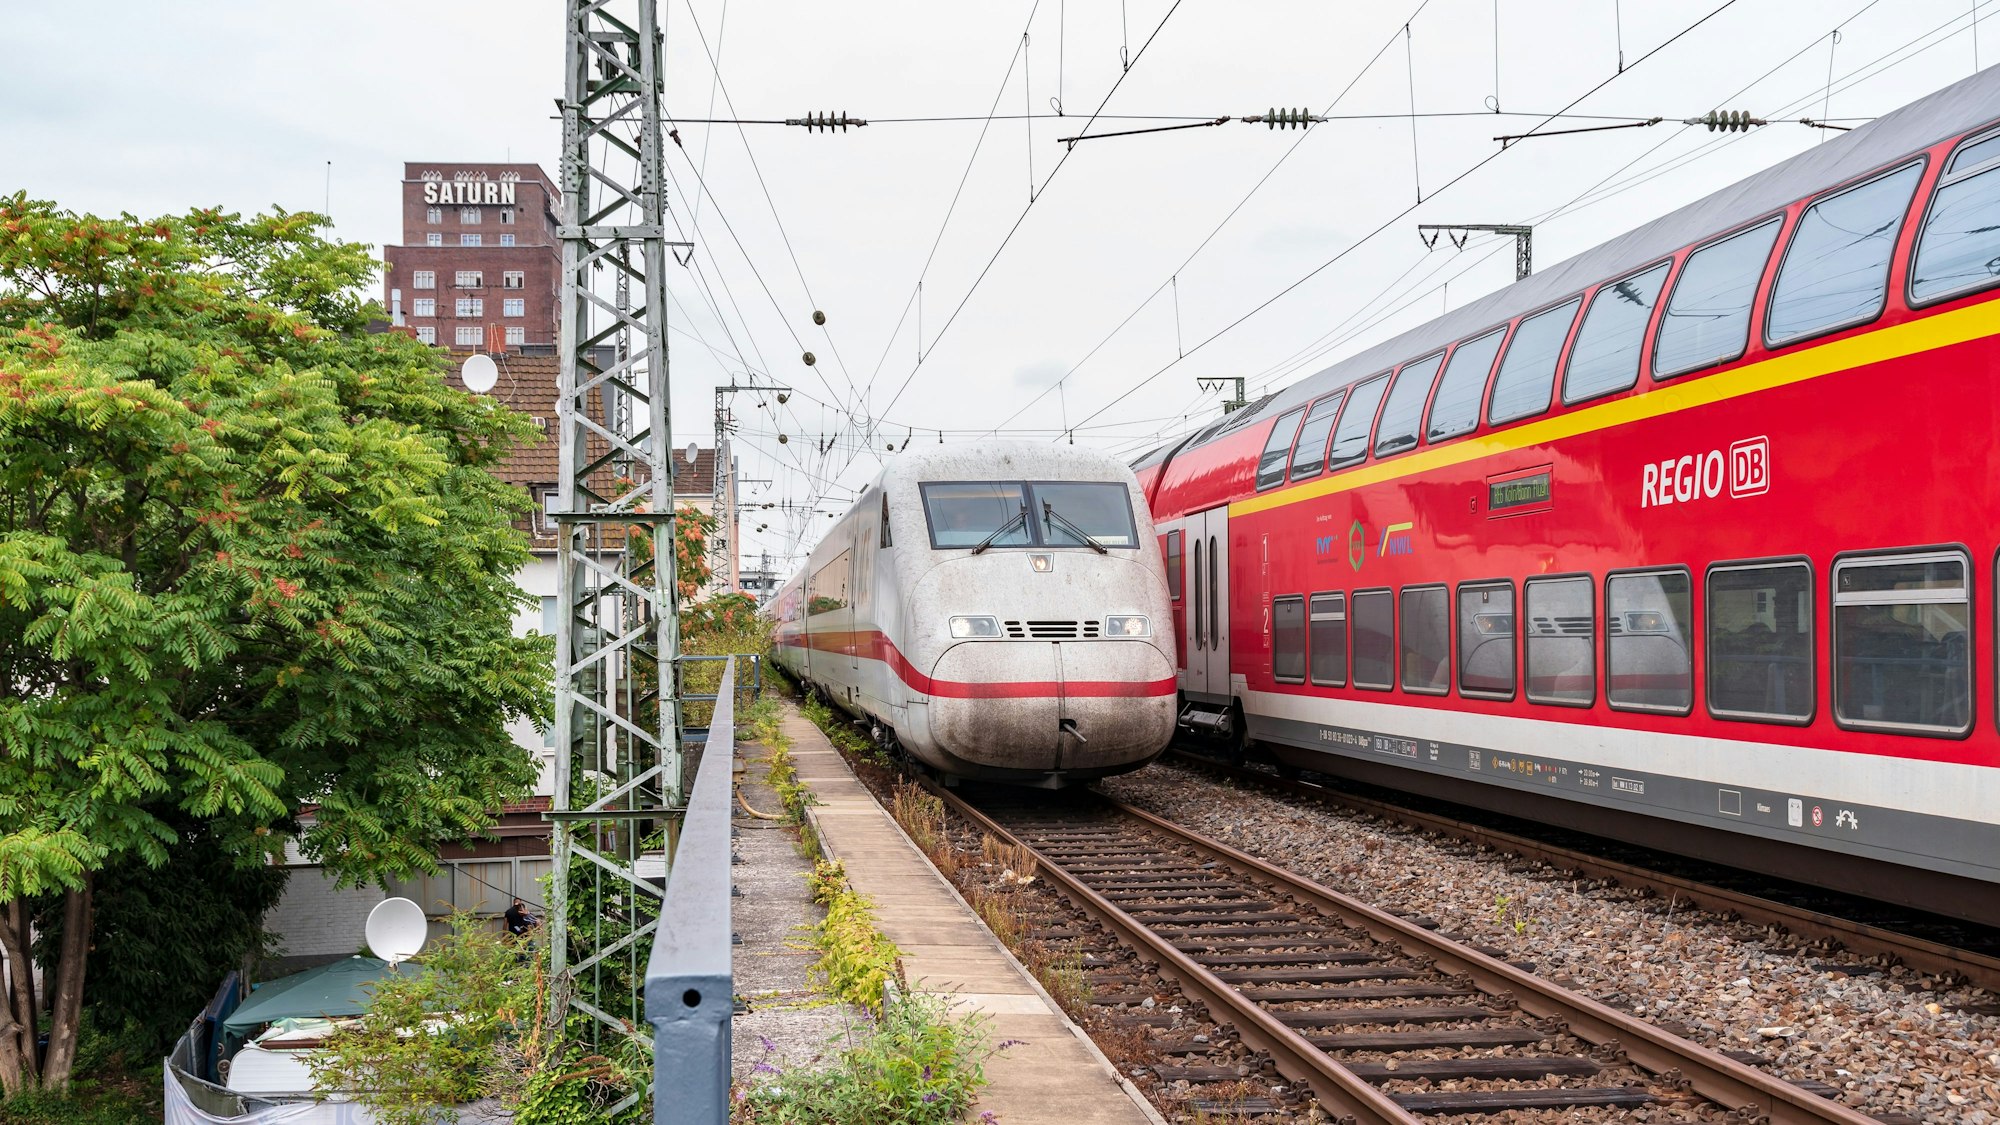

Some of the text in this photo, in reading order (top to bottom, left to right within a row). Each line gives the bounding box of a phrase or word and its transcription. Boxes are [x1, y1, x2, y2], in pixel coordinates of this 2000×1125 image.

[424, 181, 515, 205] SATURN
[1641, 443, 1766, 508] REGIO DB
[1263, 536, 1268, 562] 1
[1390, 536, 1414, 556] NWL
[1263, 607, 1269, 634] 2
